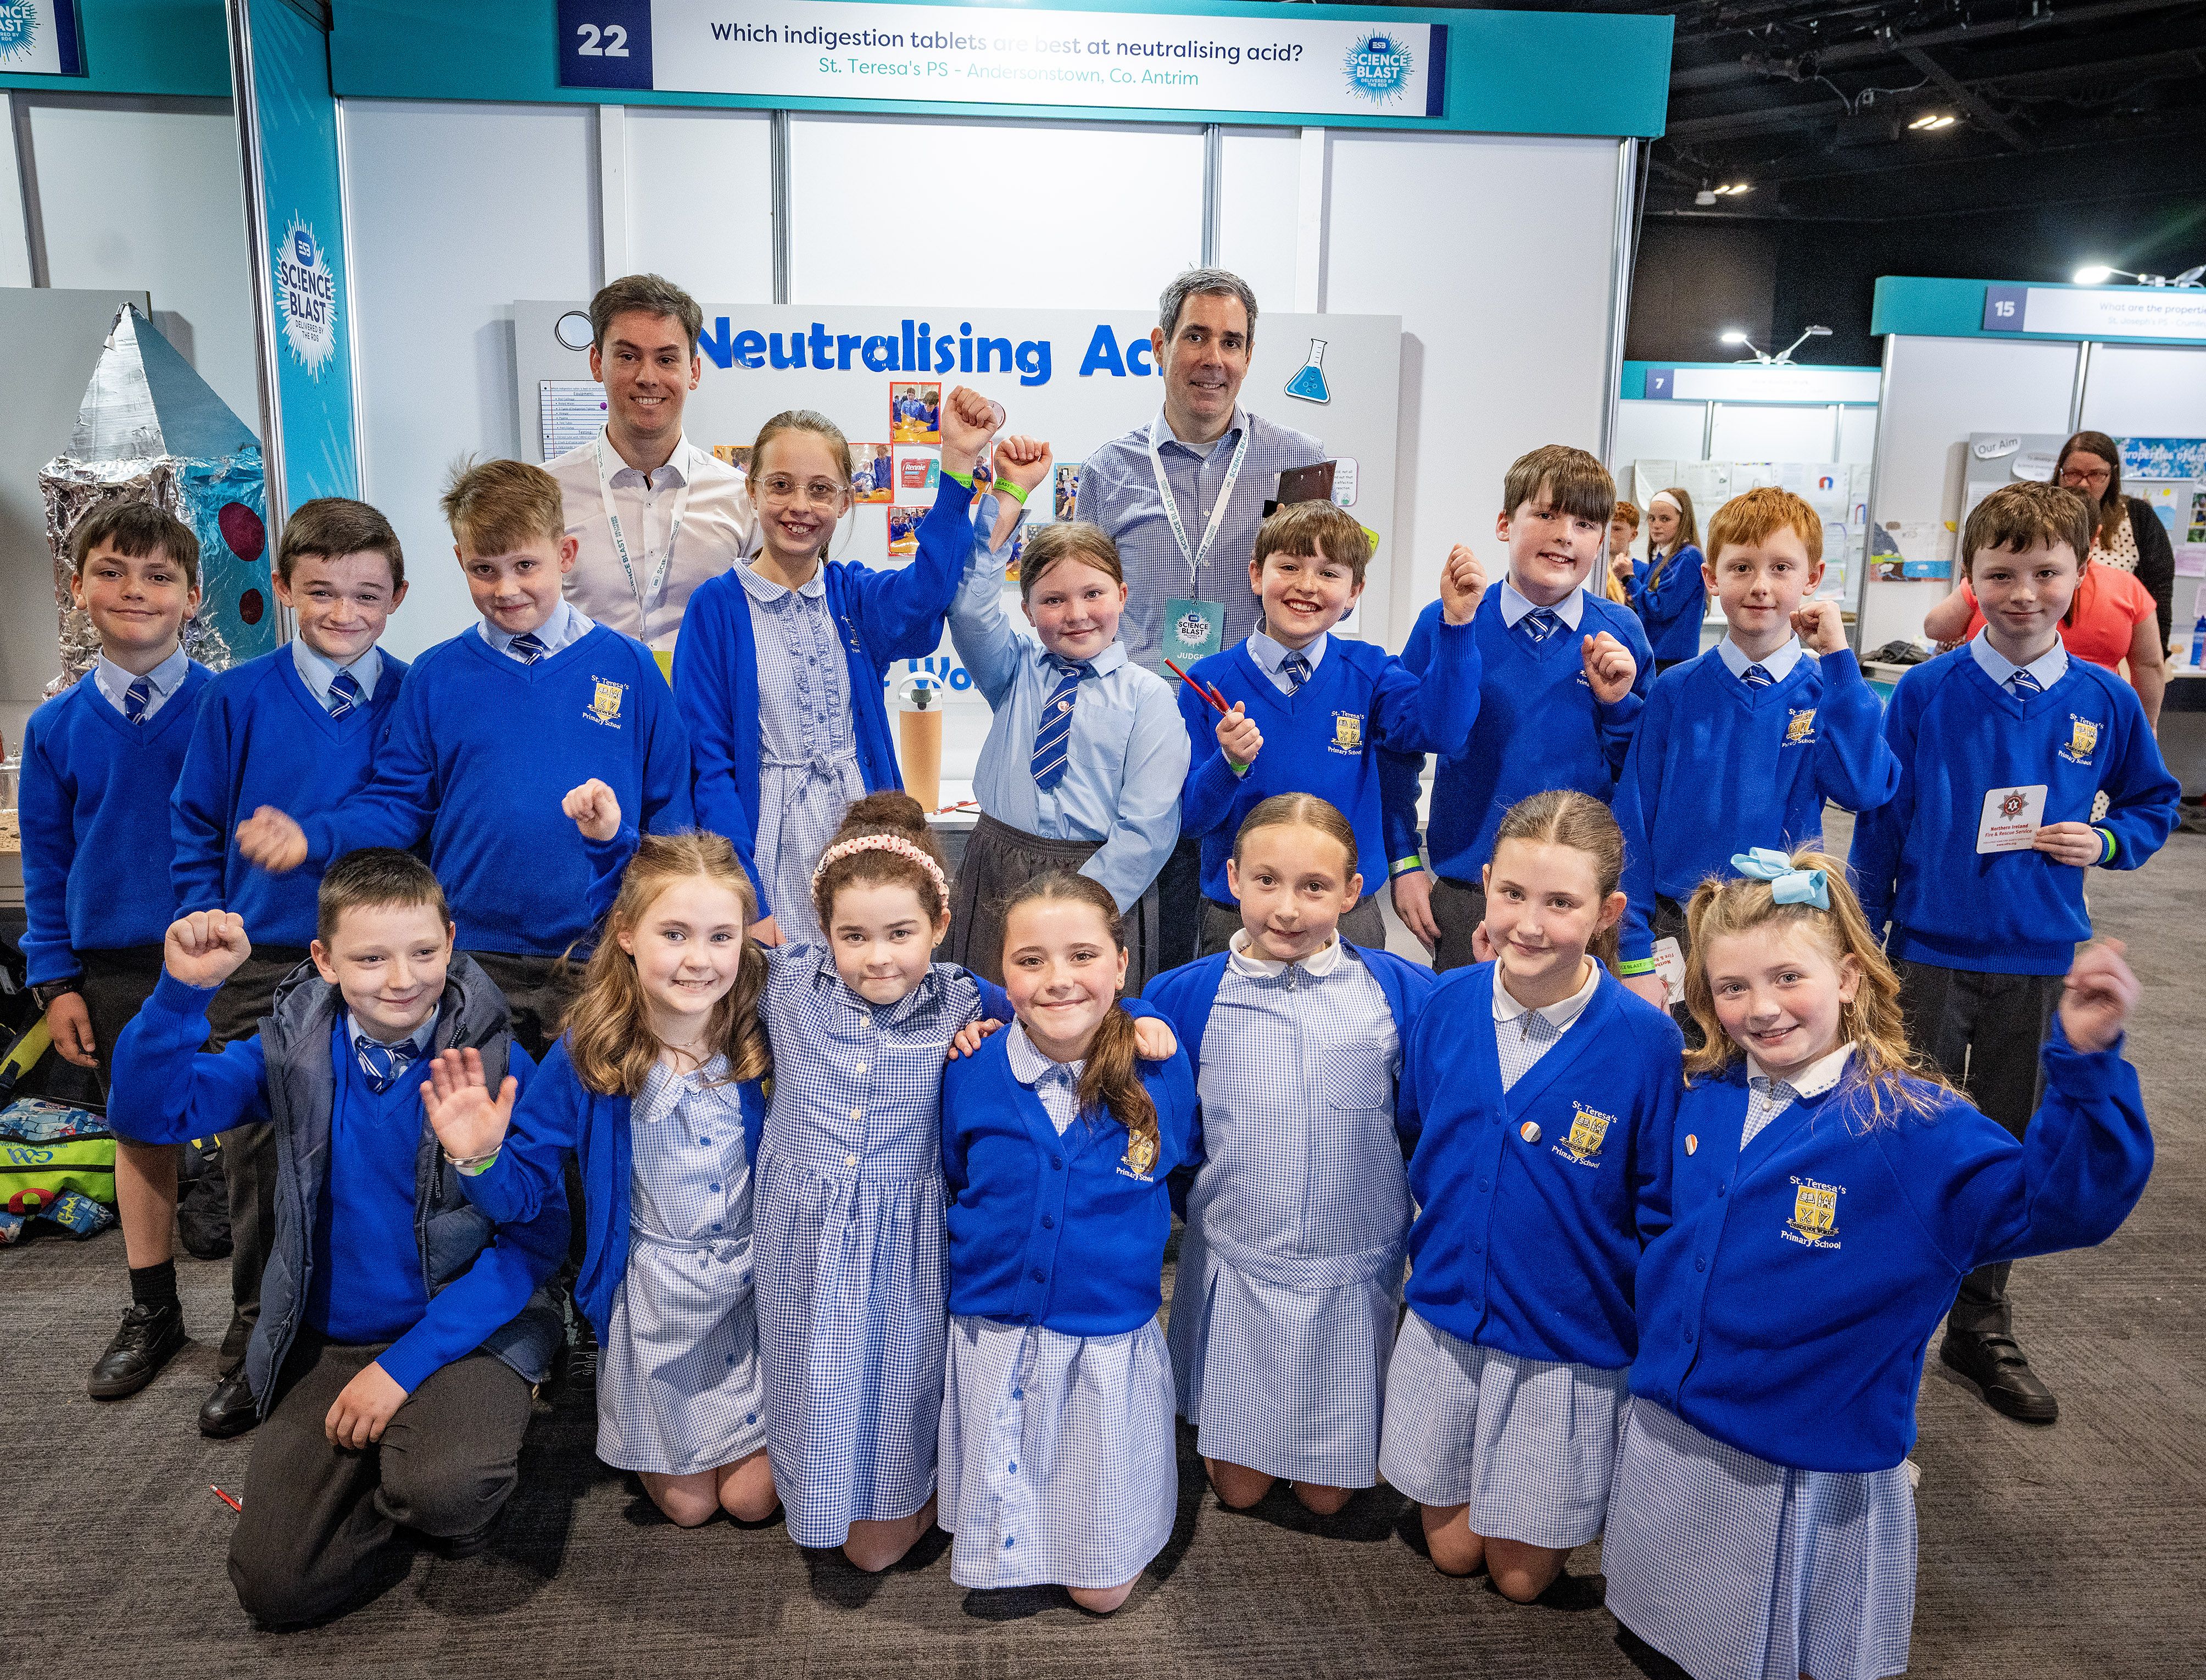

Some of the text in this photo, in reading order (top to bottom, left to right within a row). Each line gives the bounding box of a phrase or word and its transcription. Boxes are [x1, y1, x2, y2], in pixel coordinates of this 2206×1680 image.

[0, 19, 23, 32] AST
[577, 24, 630, 57] 22
[711, 23, 1303, 65] Which indigestion tablets are best at neutralising acid?
[819, 57, 842, 74] St.
[848, 58, 921, 76] Teresa's
[927, 62, 948, 77] PS
[967, 63, 1104, 85] Andersonstown,
[1110, 68, 1137, 84] Co.
[1141, 69, 1199, 86] Antrim
[1357, 66, 1400, 79] BLAST
[289, 291, 326, 325] BLAST
[1995, 301, 2015, 317] 15
[2099, 302, 2125, 312] What
[2147, 304, 2163, 313] the
[295, 320, 318, 333] DELIVERED
[302, 331, 311, 340] THE
[696, 316, 1163, 386] Neutralising Ac
[1655, 378, 1664, 389] 7
[1240, 429, 1249, 449] BLAST
[1978, 438, 2018, 454] Our Aim
[1166, 500, 1179, 522] BLAST
[610, 516, 619, 538] DELIVERED
[617, 539, 630, 563] BLAST
[1195, 545, 1208, 564] BLAST
[591, 675, 630, 690] St. Teresa's
[582, 712, 621, 730] Primary School
[1341, 710, 1364, 720] Teresa's
[2070, 713, 2104, 730] St. Teresa's
[1328, 746, 1347, 755] Primary
[2058, 749, 2075, 763] Primary
[2076, 758, 2092, 766] School
[1654, 959, 1671, 967] Northe
[1572, 1100, 1618, 1123] St. Teresa's
[1551, 1145, 1600, 1169] Primary School
[1116, 1167, 1154, 1183] Primary School
[1790, 1176, 1847, 1195] St. Teresa's
[1790, 1222, 1806, 1231] DEEDS
[1781, 1230, 1841, 1250] Primary School
